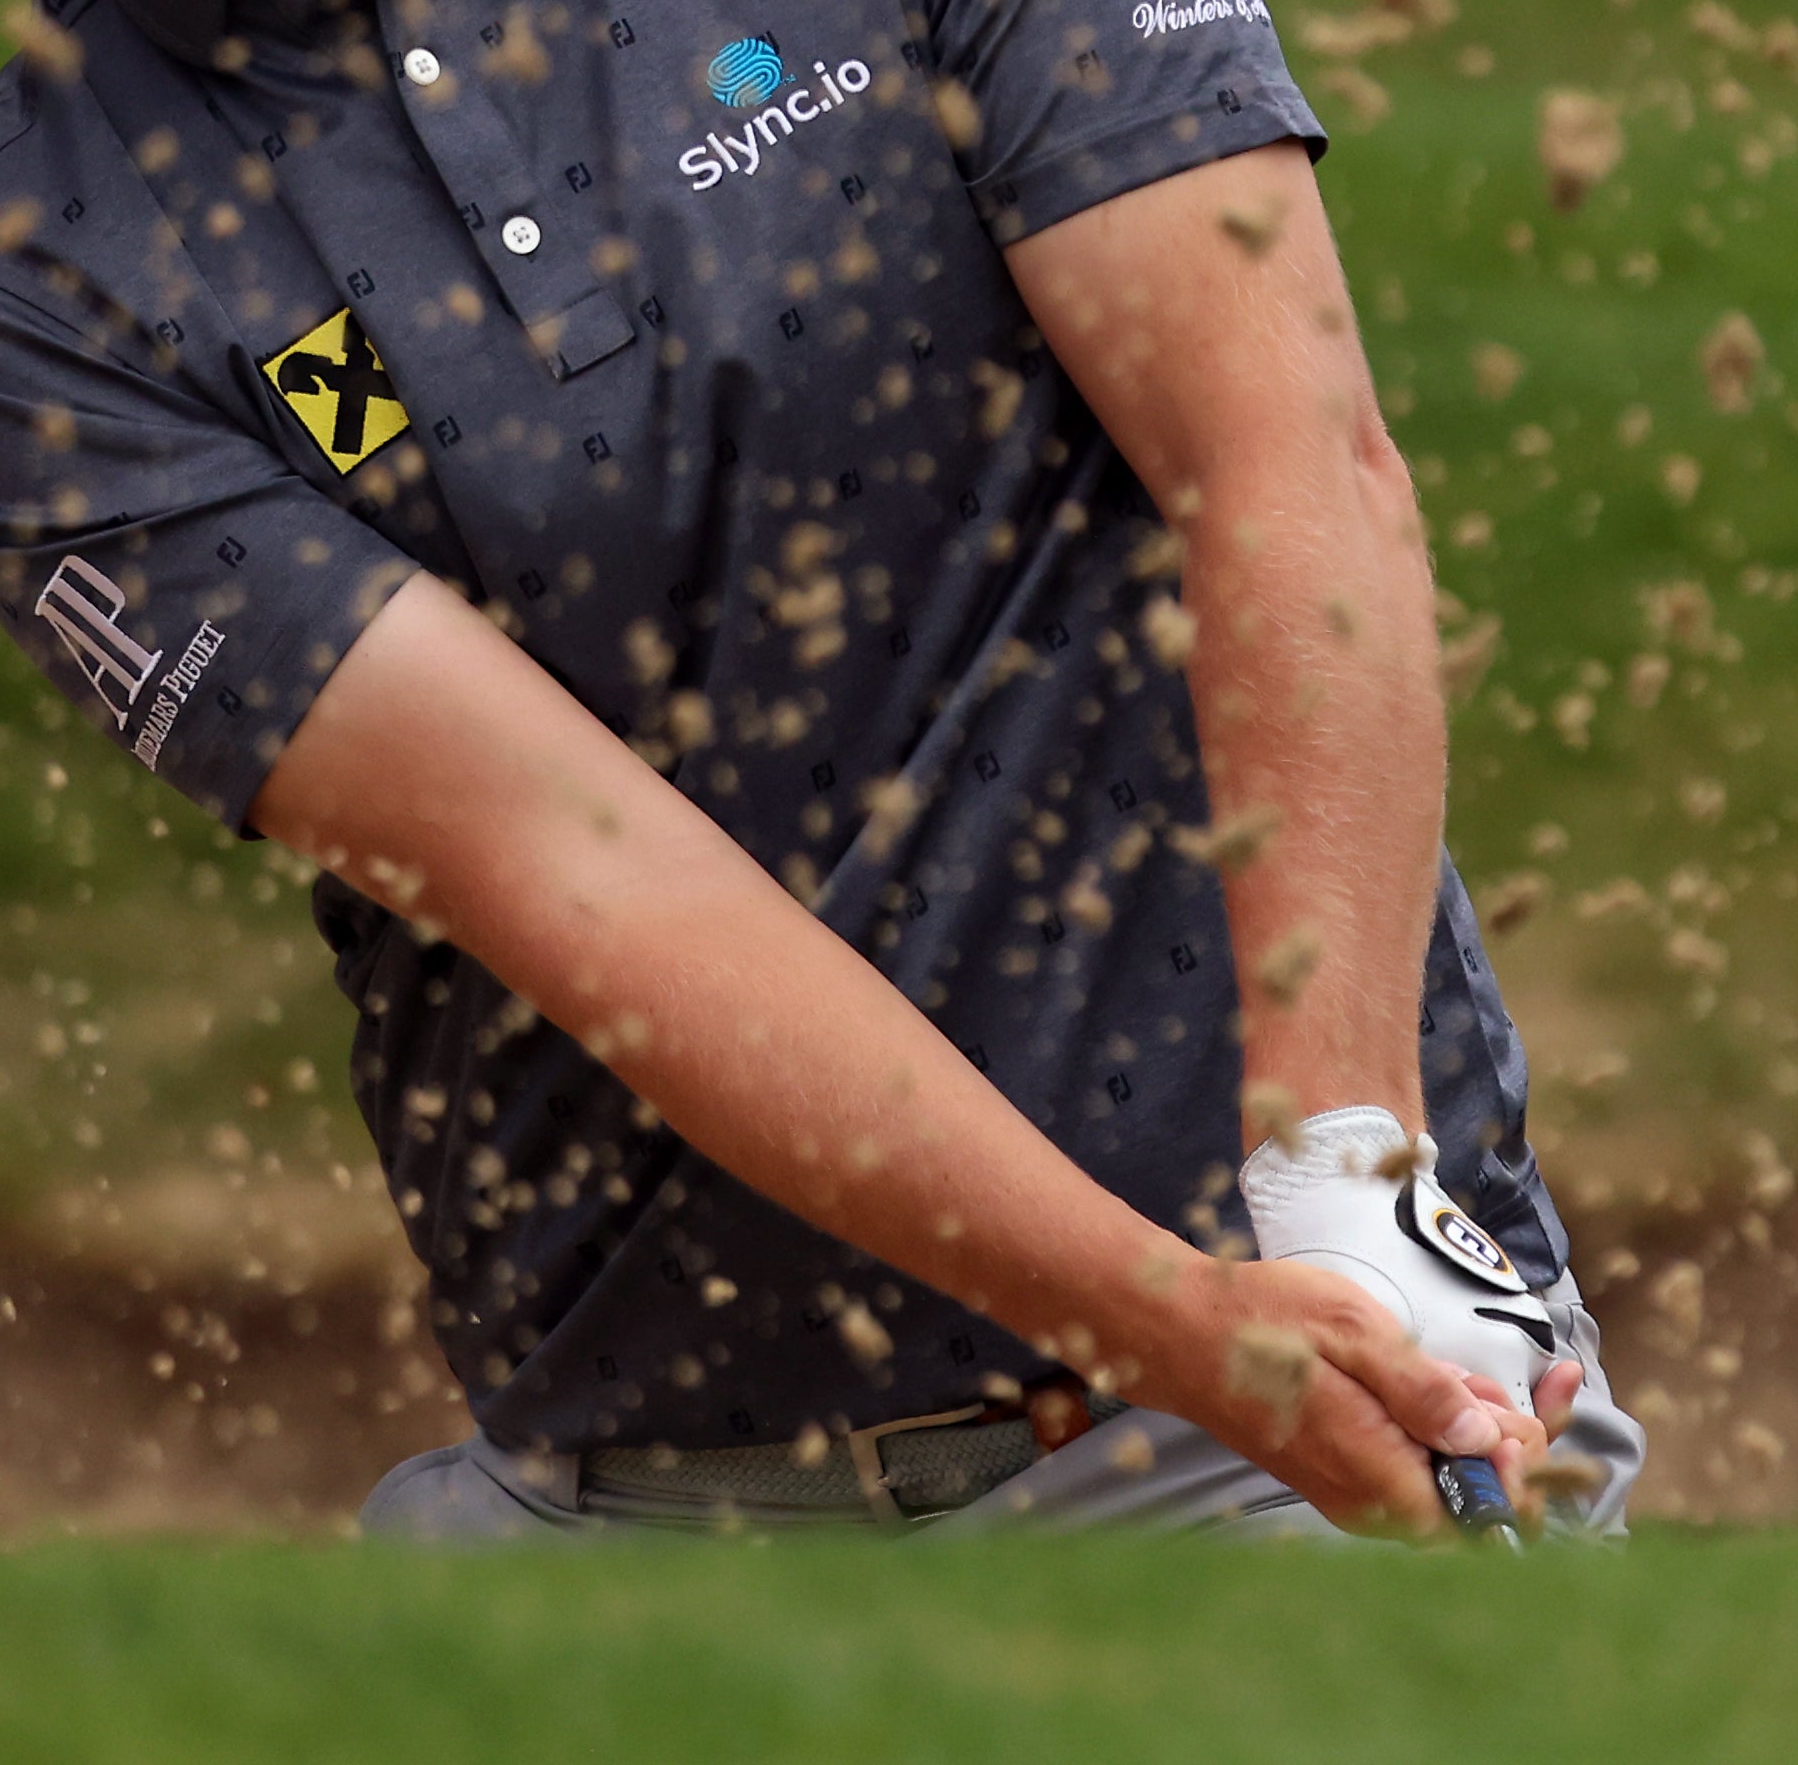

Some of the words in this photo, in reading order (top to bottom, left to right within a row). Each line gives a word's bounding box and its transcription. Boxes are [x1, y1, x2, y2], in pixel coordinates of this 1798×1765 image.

[678, 58, 871, 191] Slync.io
[34, 554, 163, 731] AP
[160, 619, 226, 704] PIGUET
[1445, 1216, 1500, 1268] FJ
